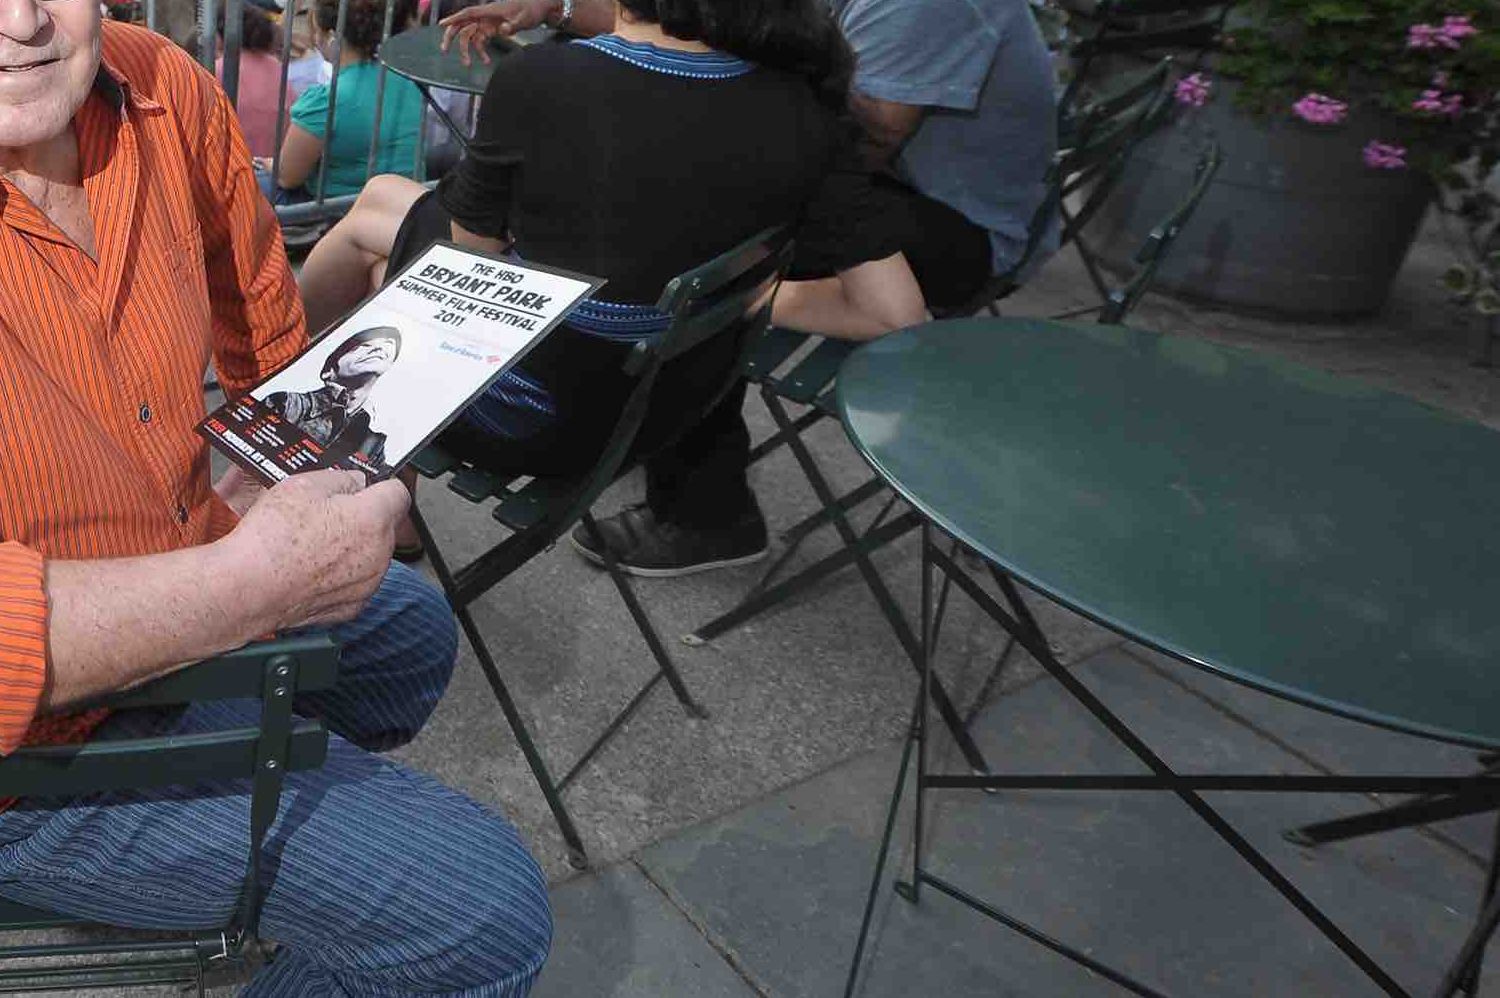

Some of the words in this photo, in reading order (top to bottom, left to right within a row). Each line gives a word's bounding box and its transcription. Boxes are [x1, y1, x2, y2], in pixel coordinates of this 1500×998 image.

[419, 264, 496, 295] BRYANT
[491, 285, 552, 311] PARK
[470, 263, 496, 276] THE
[495, 269, 524, 284] HBO
[396, 279, 447, 304] SUMMER
[445, 298, 477, 314] FILM
[475, 306, 537, 331] FESTIVAL
[433, 309, 466, 327] 2011
